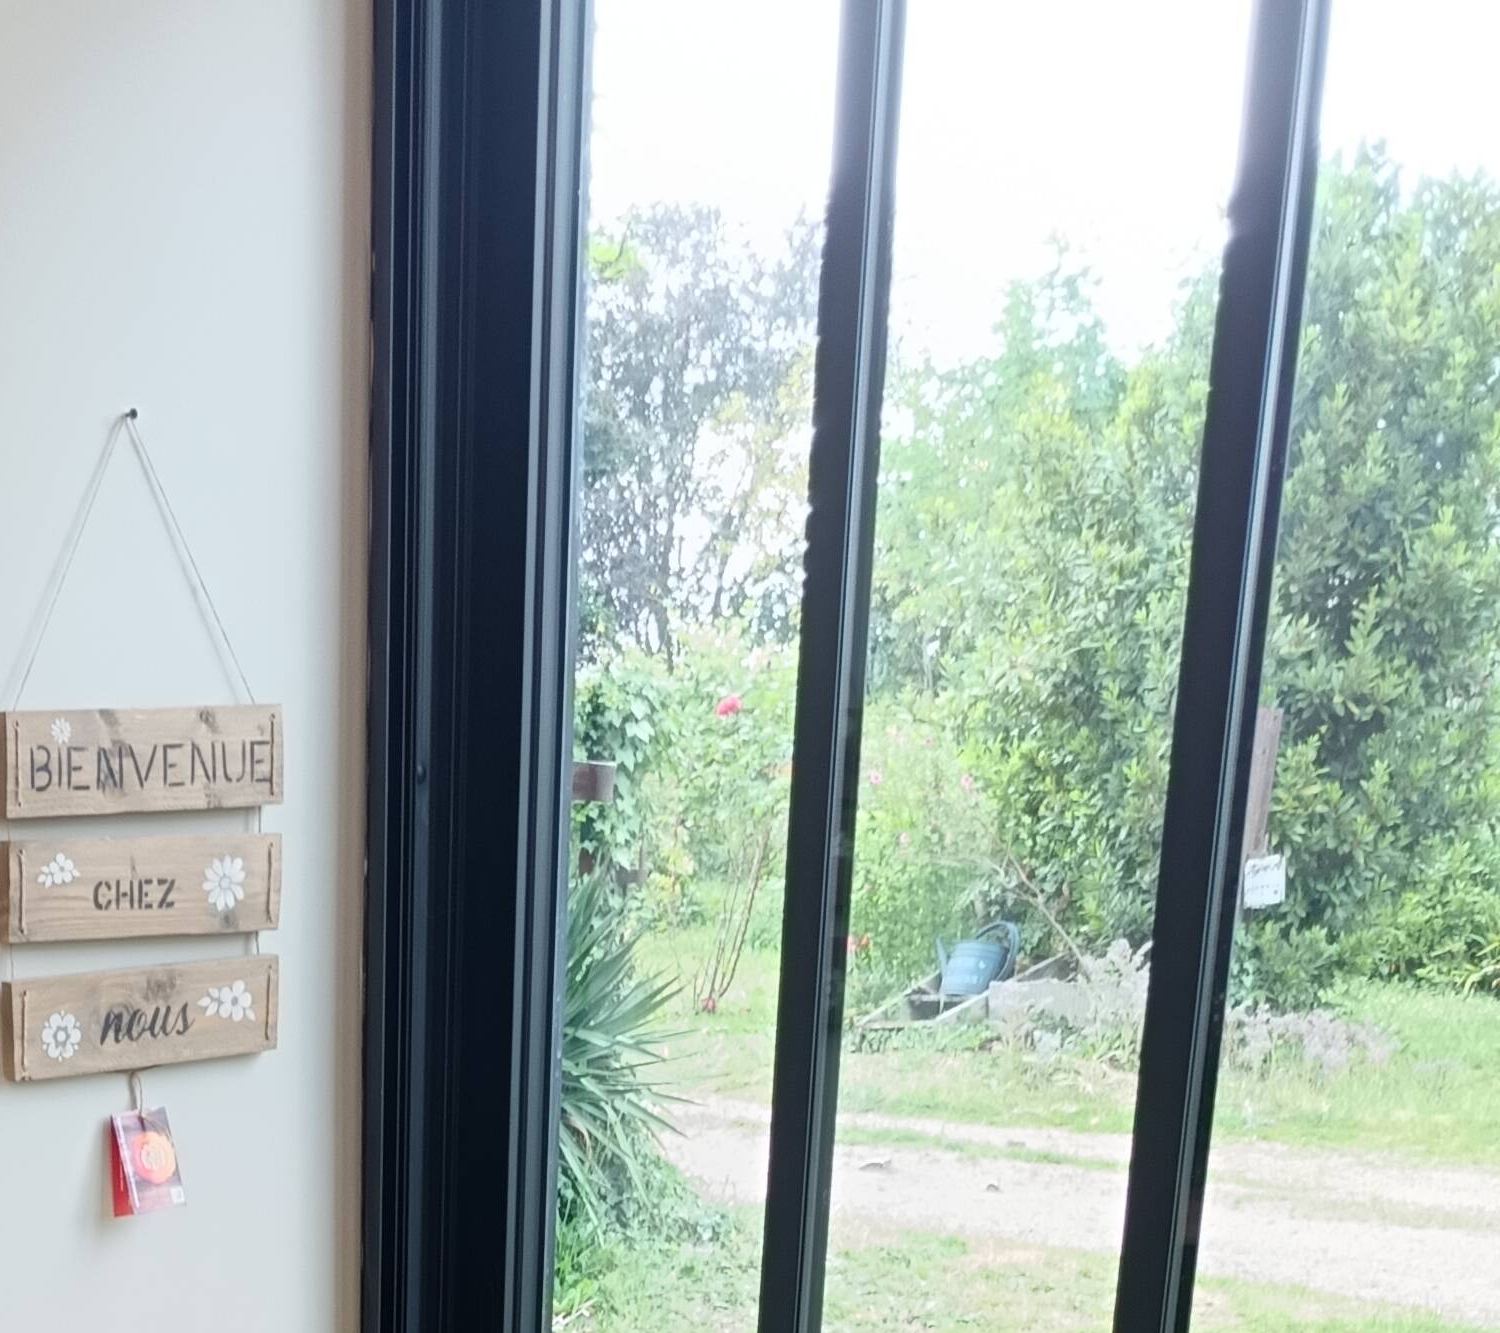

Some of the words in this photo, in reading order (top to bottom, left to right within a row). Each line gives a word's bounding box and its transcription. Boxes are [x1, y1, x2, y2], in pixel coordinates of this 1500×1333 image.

[30, 739, 272, 792] BIENVENUE
[91, 876, 177, 913] CHEZ
[99, 1002, 195, 1047] nous
